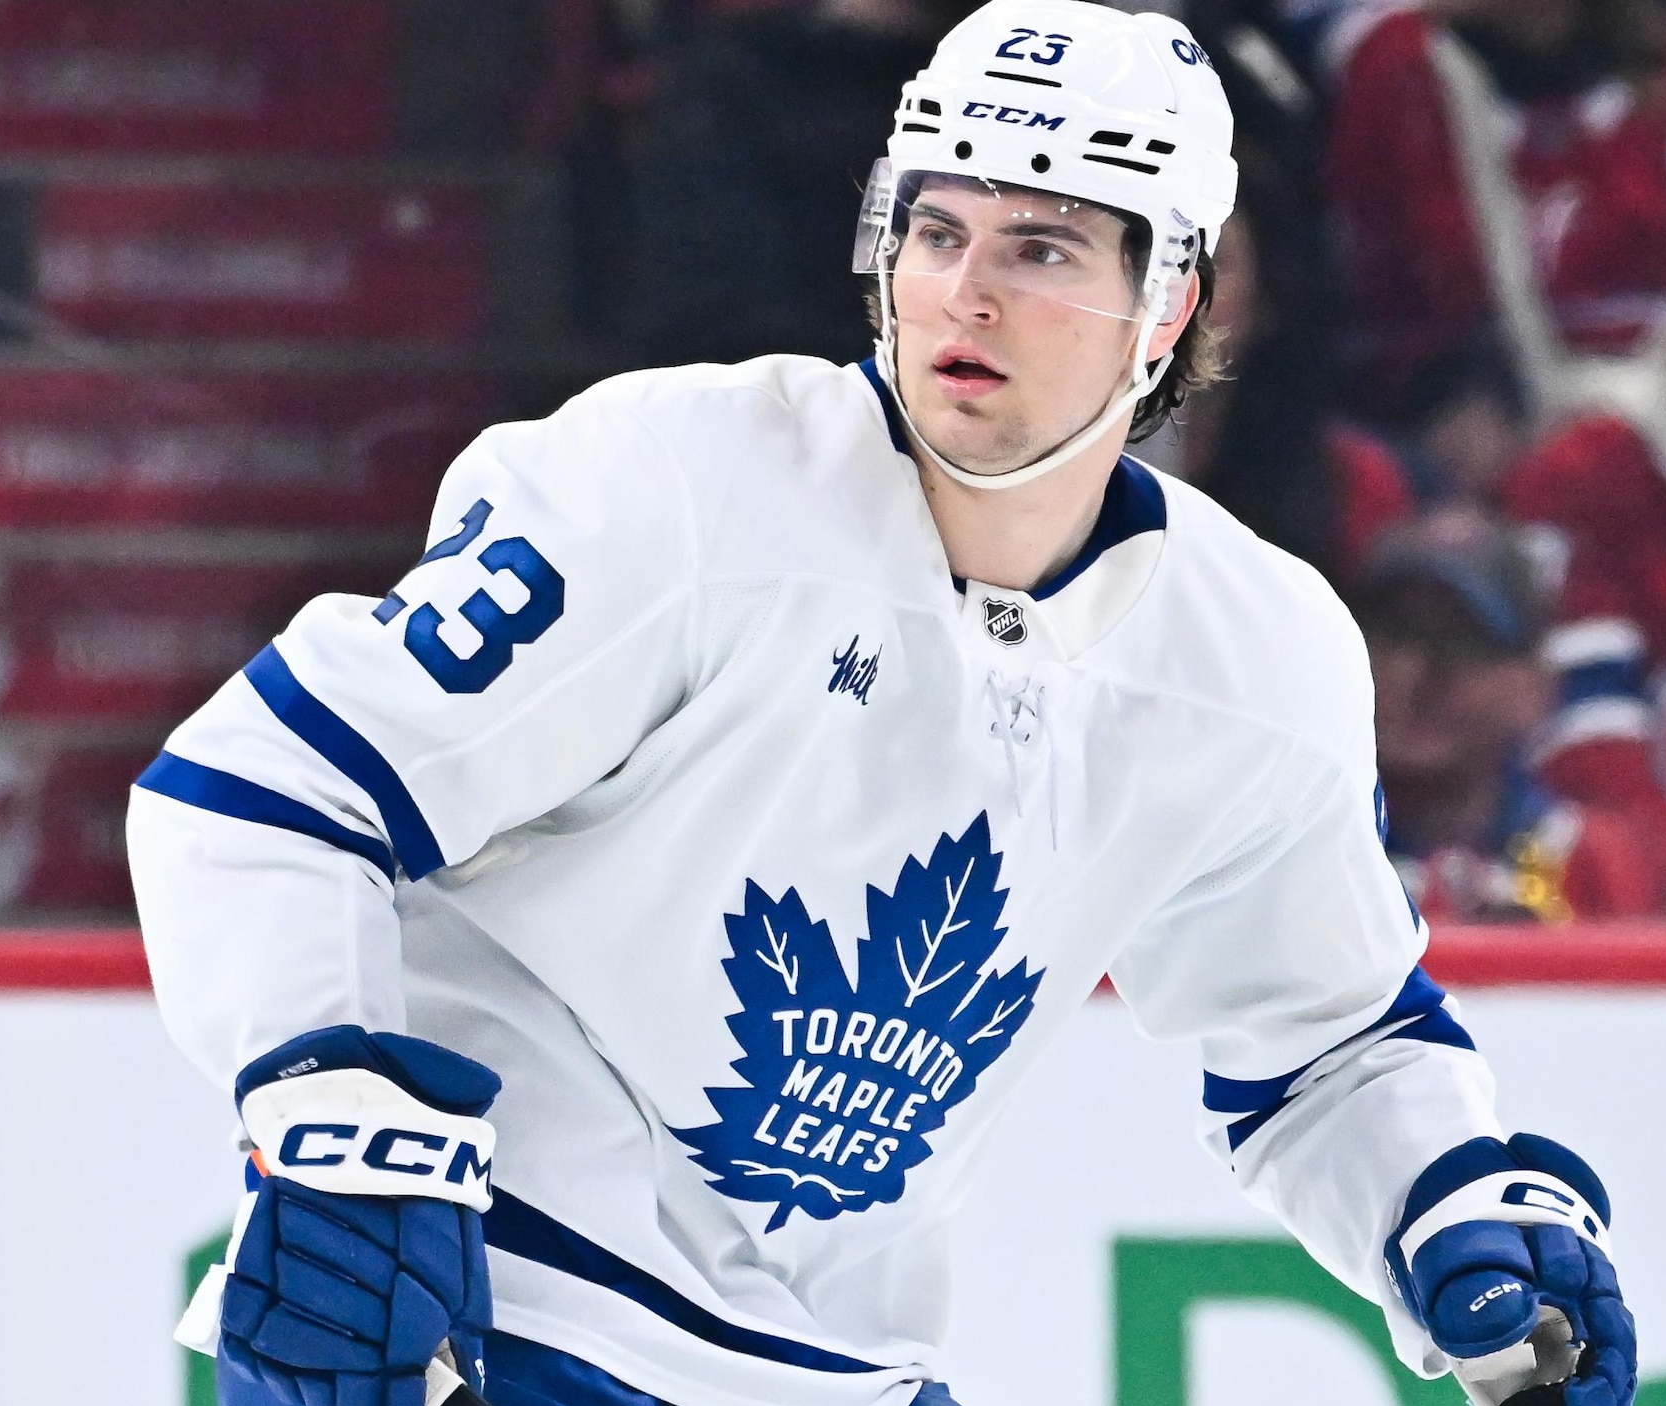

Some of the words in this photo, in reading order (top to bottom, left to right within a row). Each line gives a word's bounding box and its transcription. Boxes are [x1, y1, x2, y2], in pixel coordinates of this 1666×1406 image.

[994, 28, 1073, 66] 23
[961, 101, 1067, 131] CCM
[991, 611, 1018, 635] NHL
[772, 1008, 964, 1102] TORONTO
[780, 1059, 928, 1132] MAPLE
[753, 1103, 900, 1173] LEAFS
[1469, 1281, 1523, 1313] CCM
